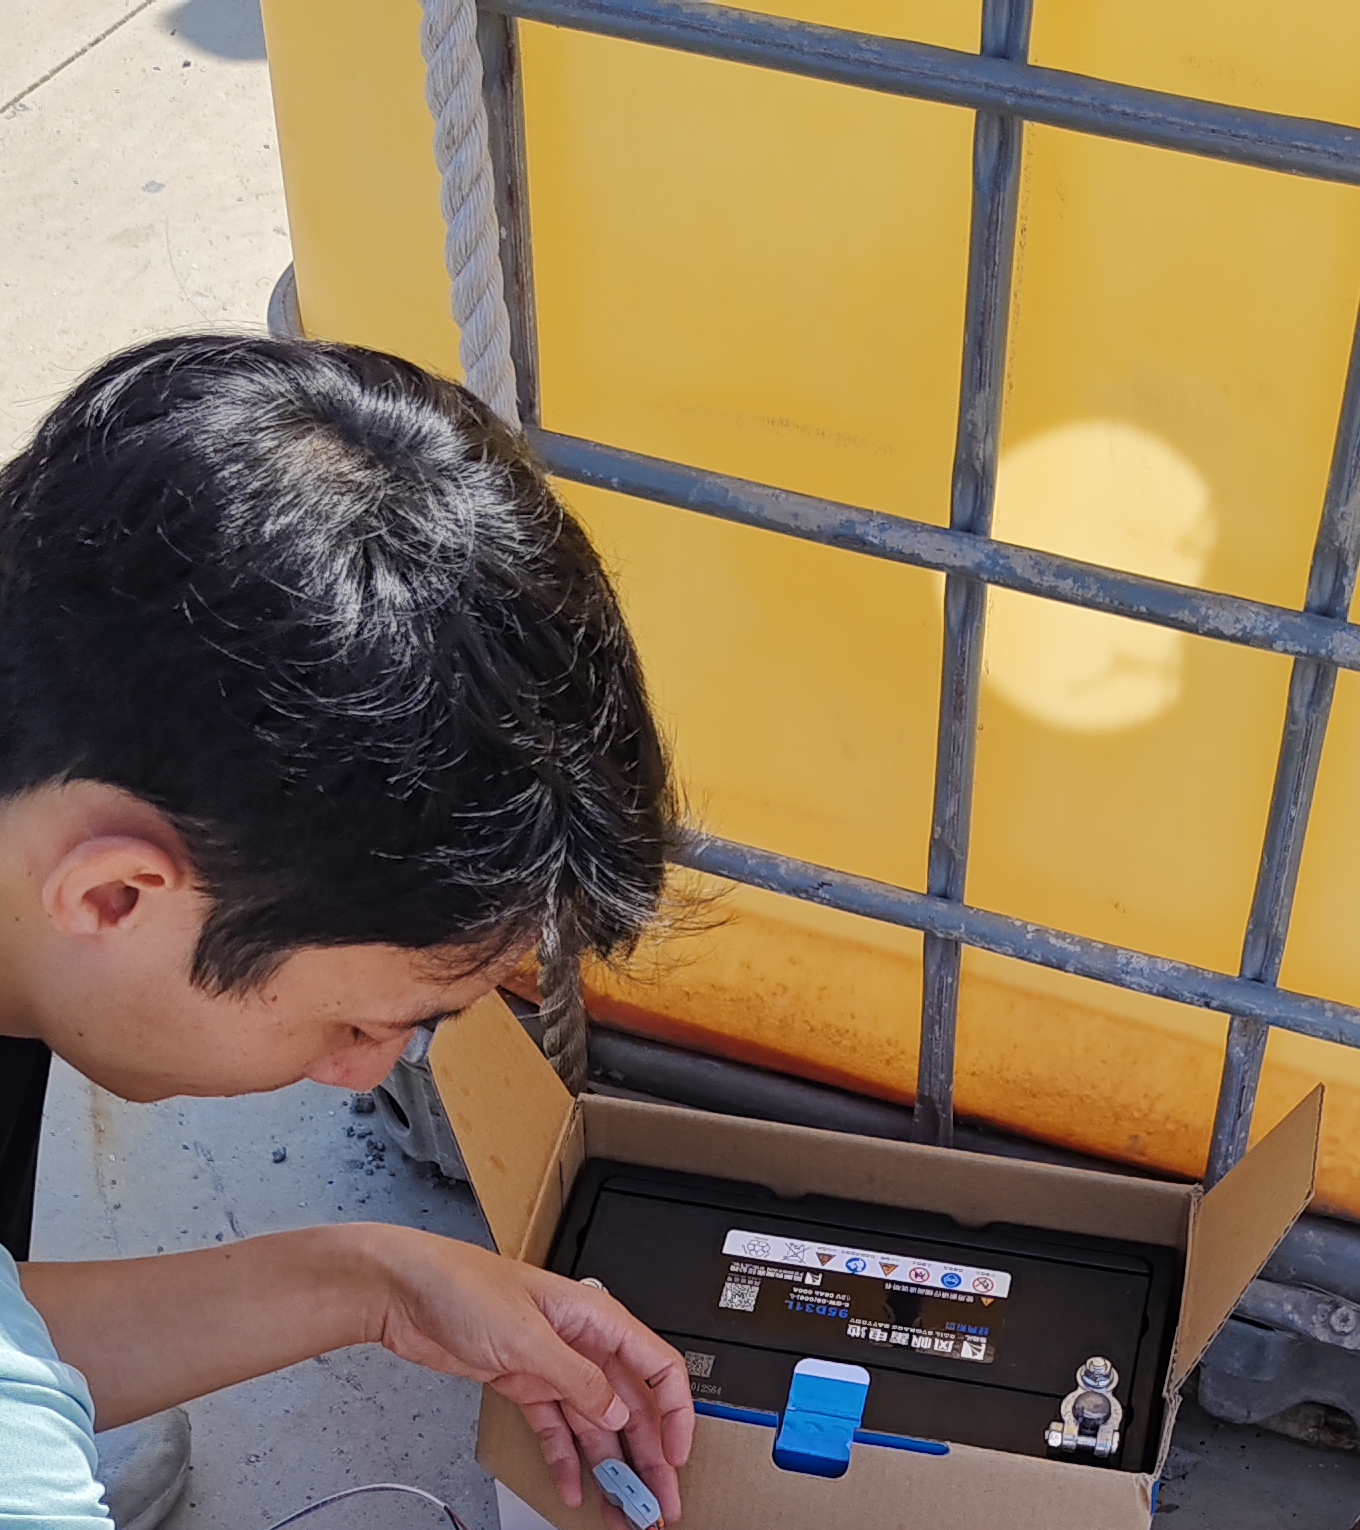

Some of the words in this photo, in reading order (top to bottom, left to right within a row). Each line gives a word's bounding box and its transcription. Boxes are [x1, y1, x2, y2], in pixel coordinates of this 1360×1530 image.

[784, 1300, 849, 1319] 95D31L
[847, 1324, 955, 1353] 风帆蓄电池
